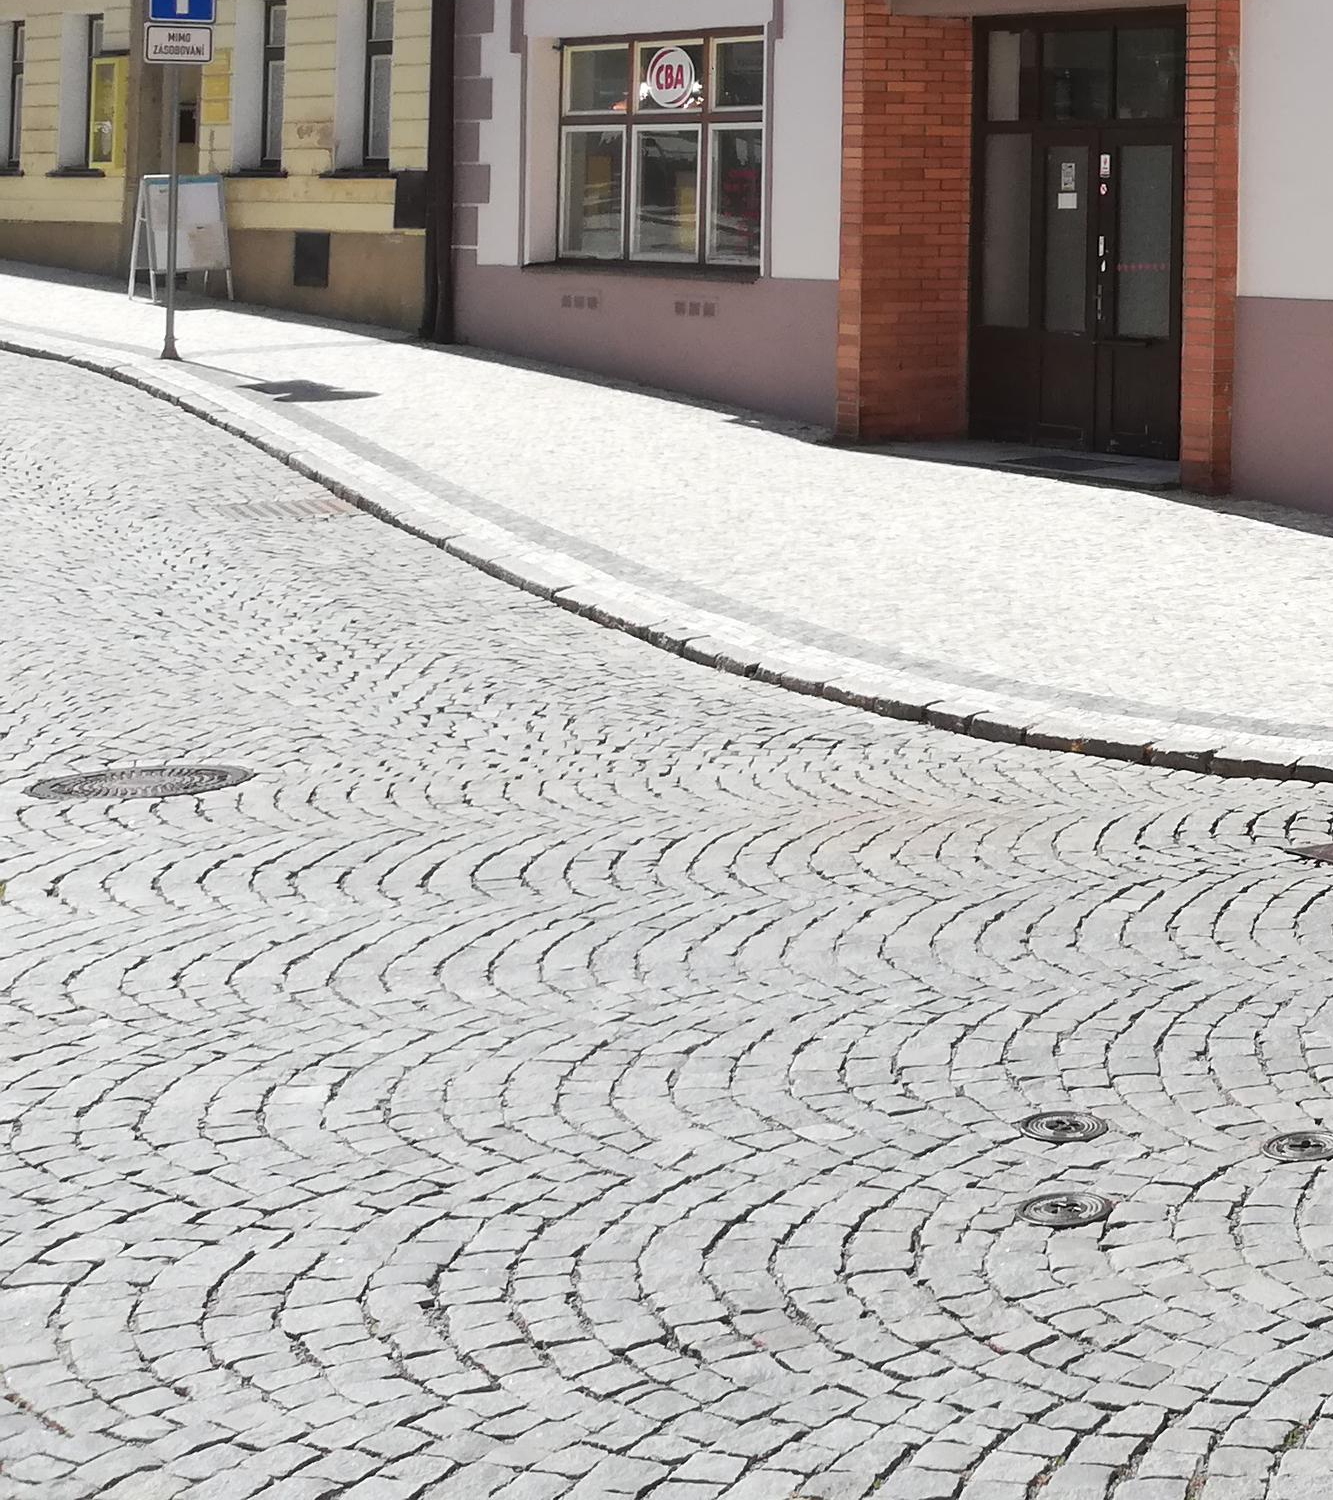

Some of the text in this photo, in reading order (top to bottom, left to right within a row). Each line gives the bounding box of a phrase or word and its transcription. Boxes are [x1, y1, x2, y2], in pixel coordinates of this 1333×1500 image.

[167, 32, 191, 43] MIMO
[153, 43, 205, 56] ZÁSOBOVÁNÍ
[655, 63, 685, 91] CBA
